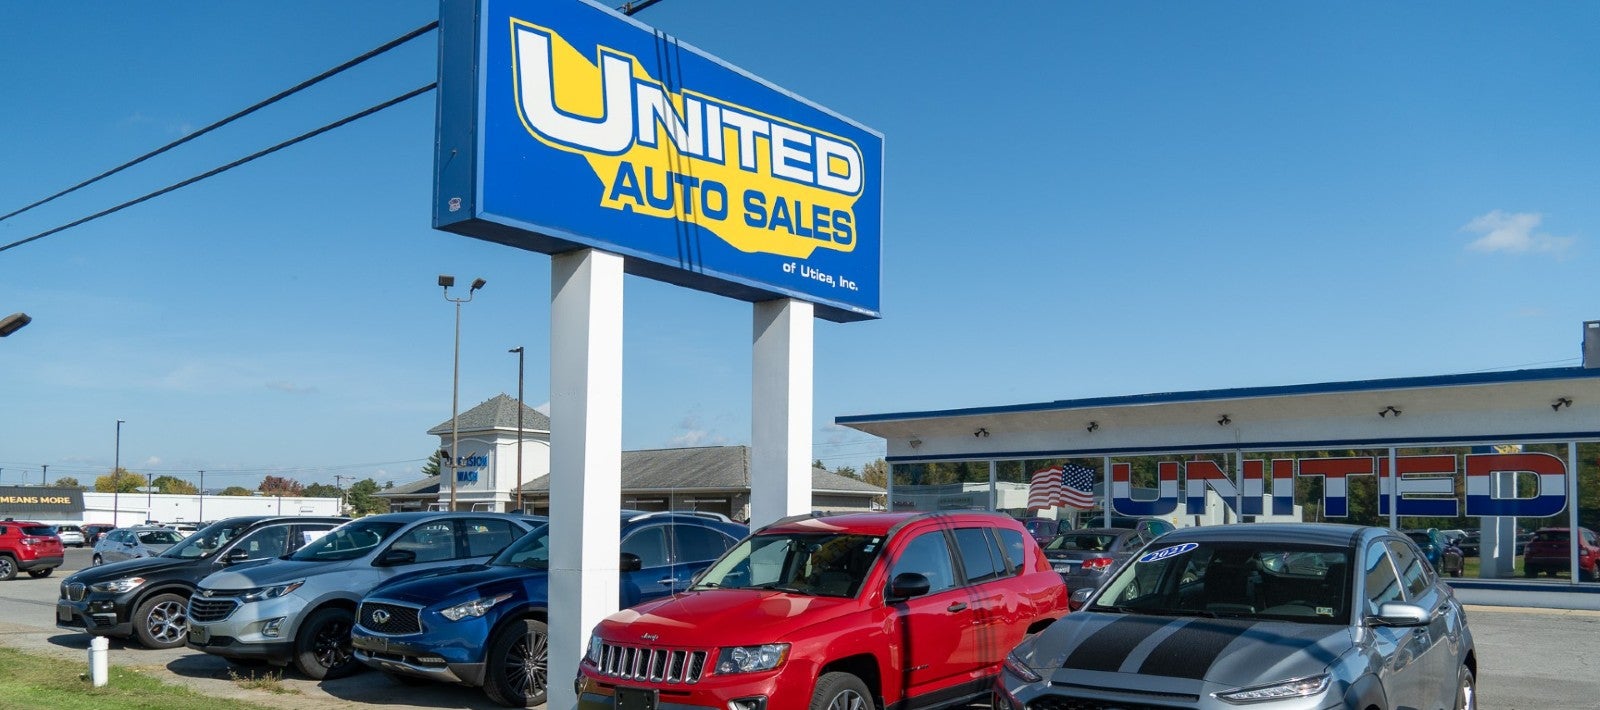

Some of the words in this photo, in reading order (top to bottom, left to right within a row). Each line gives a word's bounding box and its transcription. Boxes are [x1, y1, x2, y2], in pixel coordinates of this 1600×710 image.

[516, 27, 862, 195] UNITED
[609, 161, 728, 221] AUTO
[743, 189, 852, 245] SALES
[782, 262, 796, 274] of
[800, 264, 836, 288] Utica,
[839, 275, 859, 291] Inc.
[0, 496, 38, 504] MEANS
[40, 496, 71, 504] MORE
[1111, 452, 1568, 518] UNITED
[1150, 544, 1187, 561] 2021
